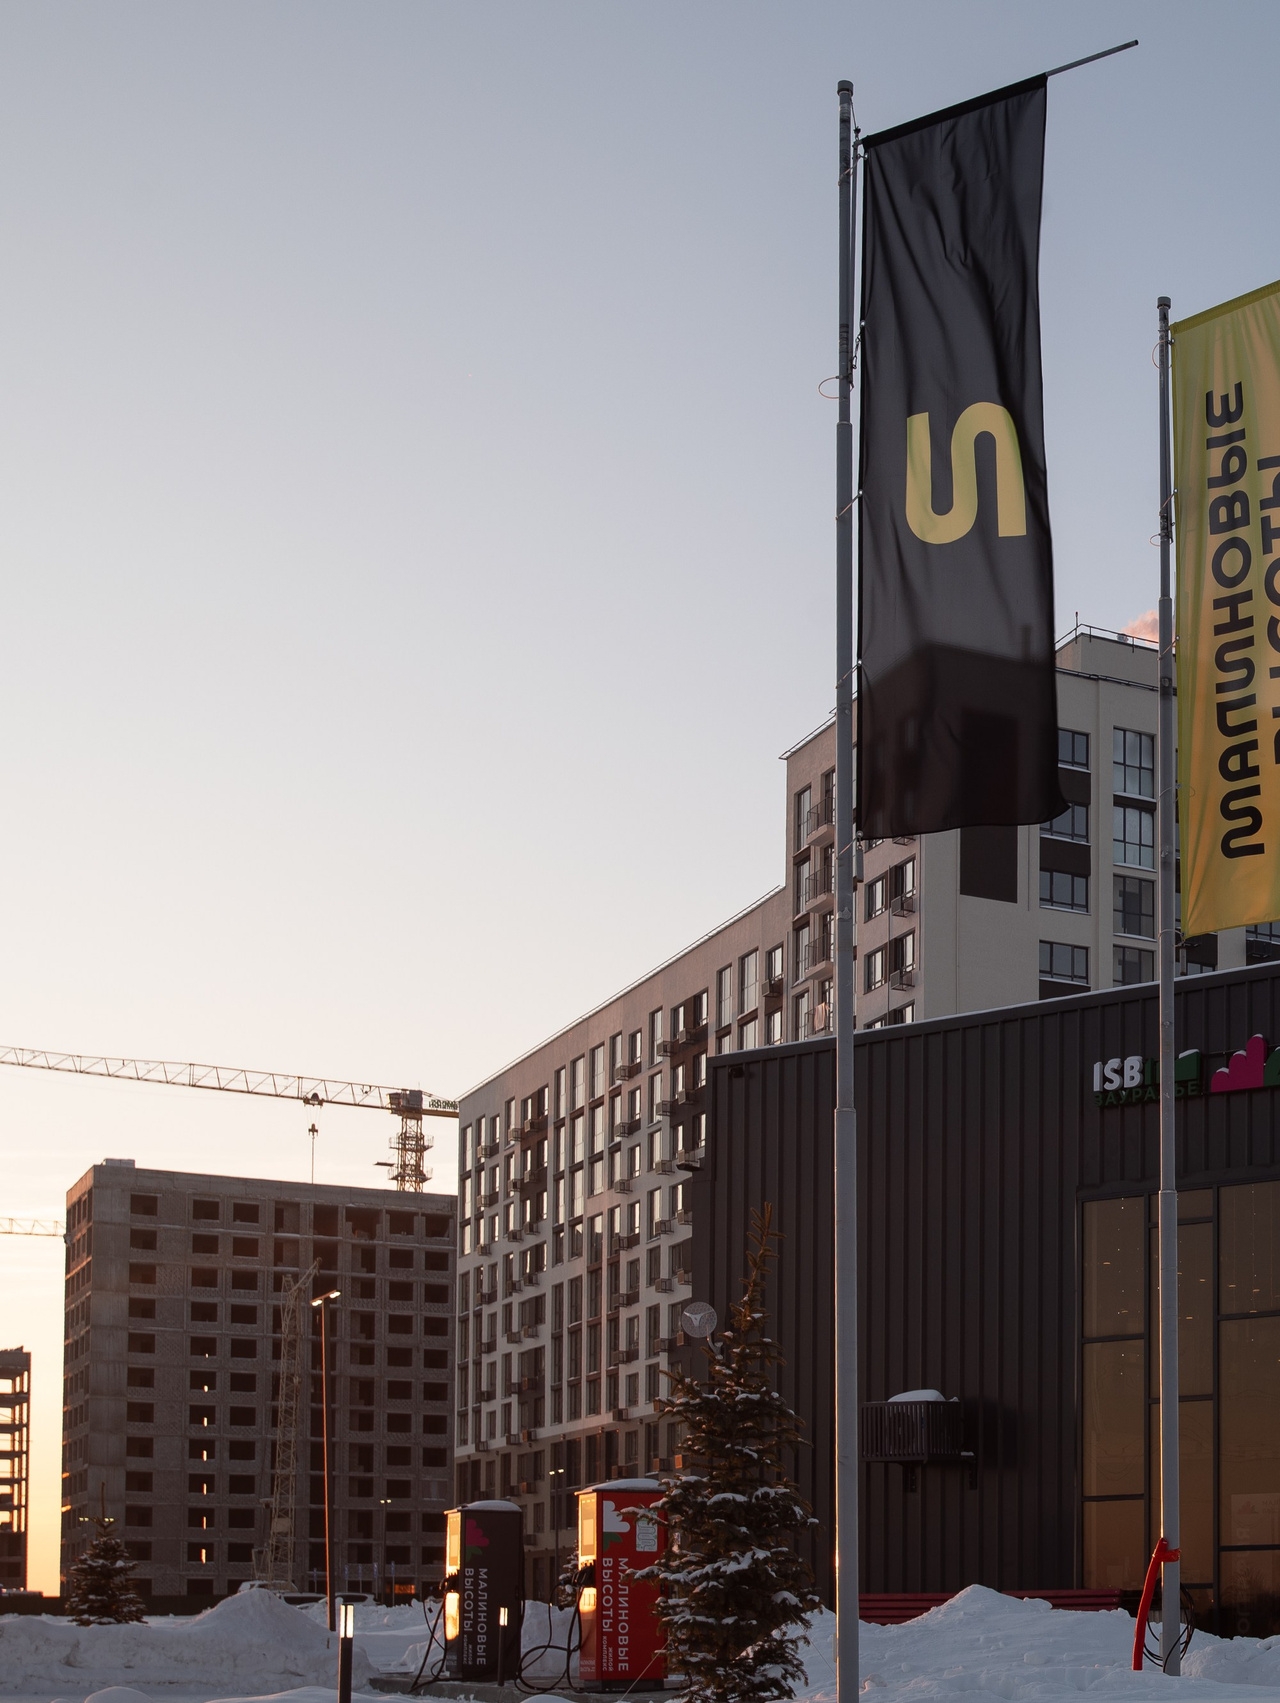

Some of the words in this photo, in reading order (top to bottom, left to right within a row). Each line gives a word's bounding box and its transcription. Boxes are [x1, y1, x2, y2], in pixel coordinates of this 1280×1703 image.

[1205, 380, 1265, 860] МАЛИНОВЫЕ
[1094, 1081, 1199, 1107] ЗАУРАЬЕ
[464, 1568, 474, 1631] ВЫСОТЫ
[476, 1568, 488, 1665] МАЛИНОВЫЕ
[602, 1557, 613, 1632] ВЫСОТЫ
